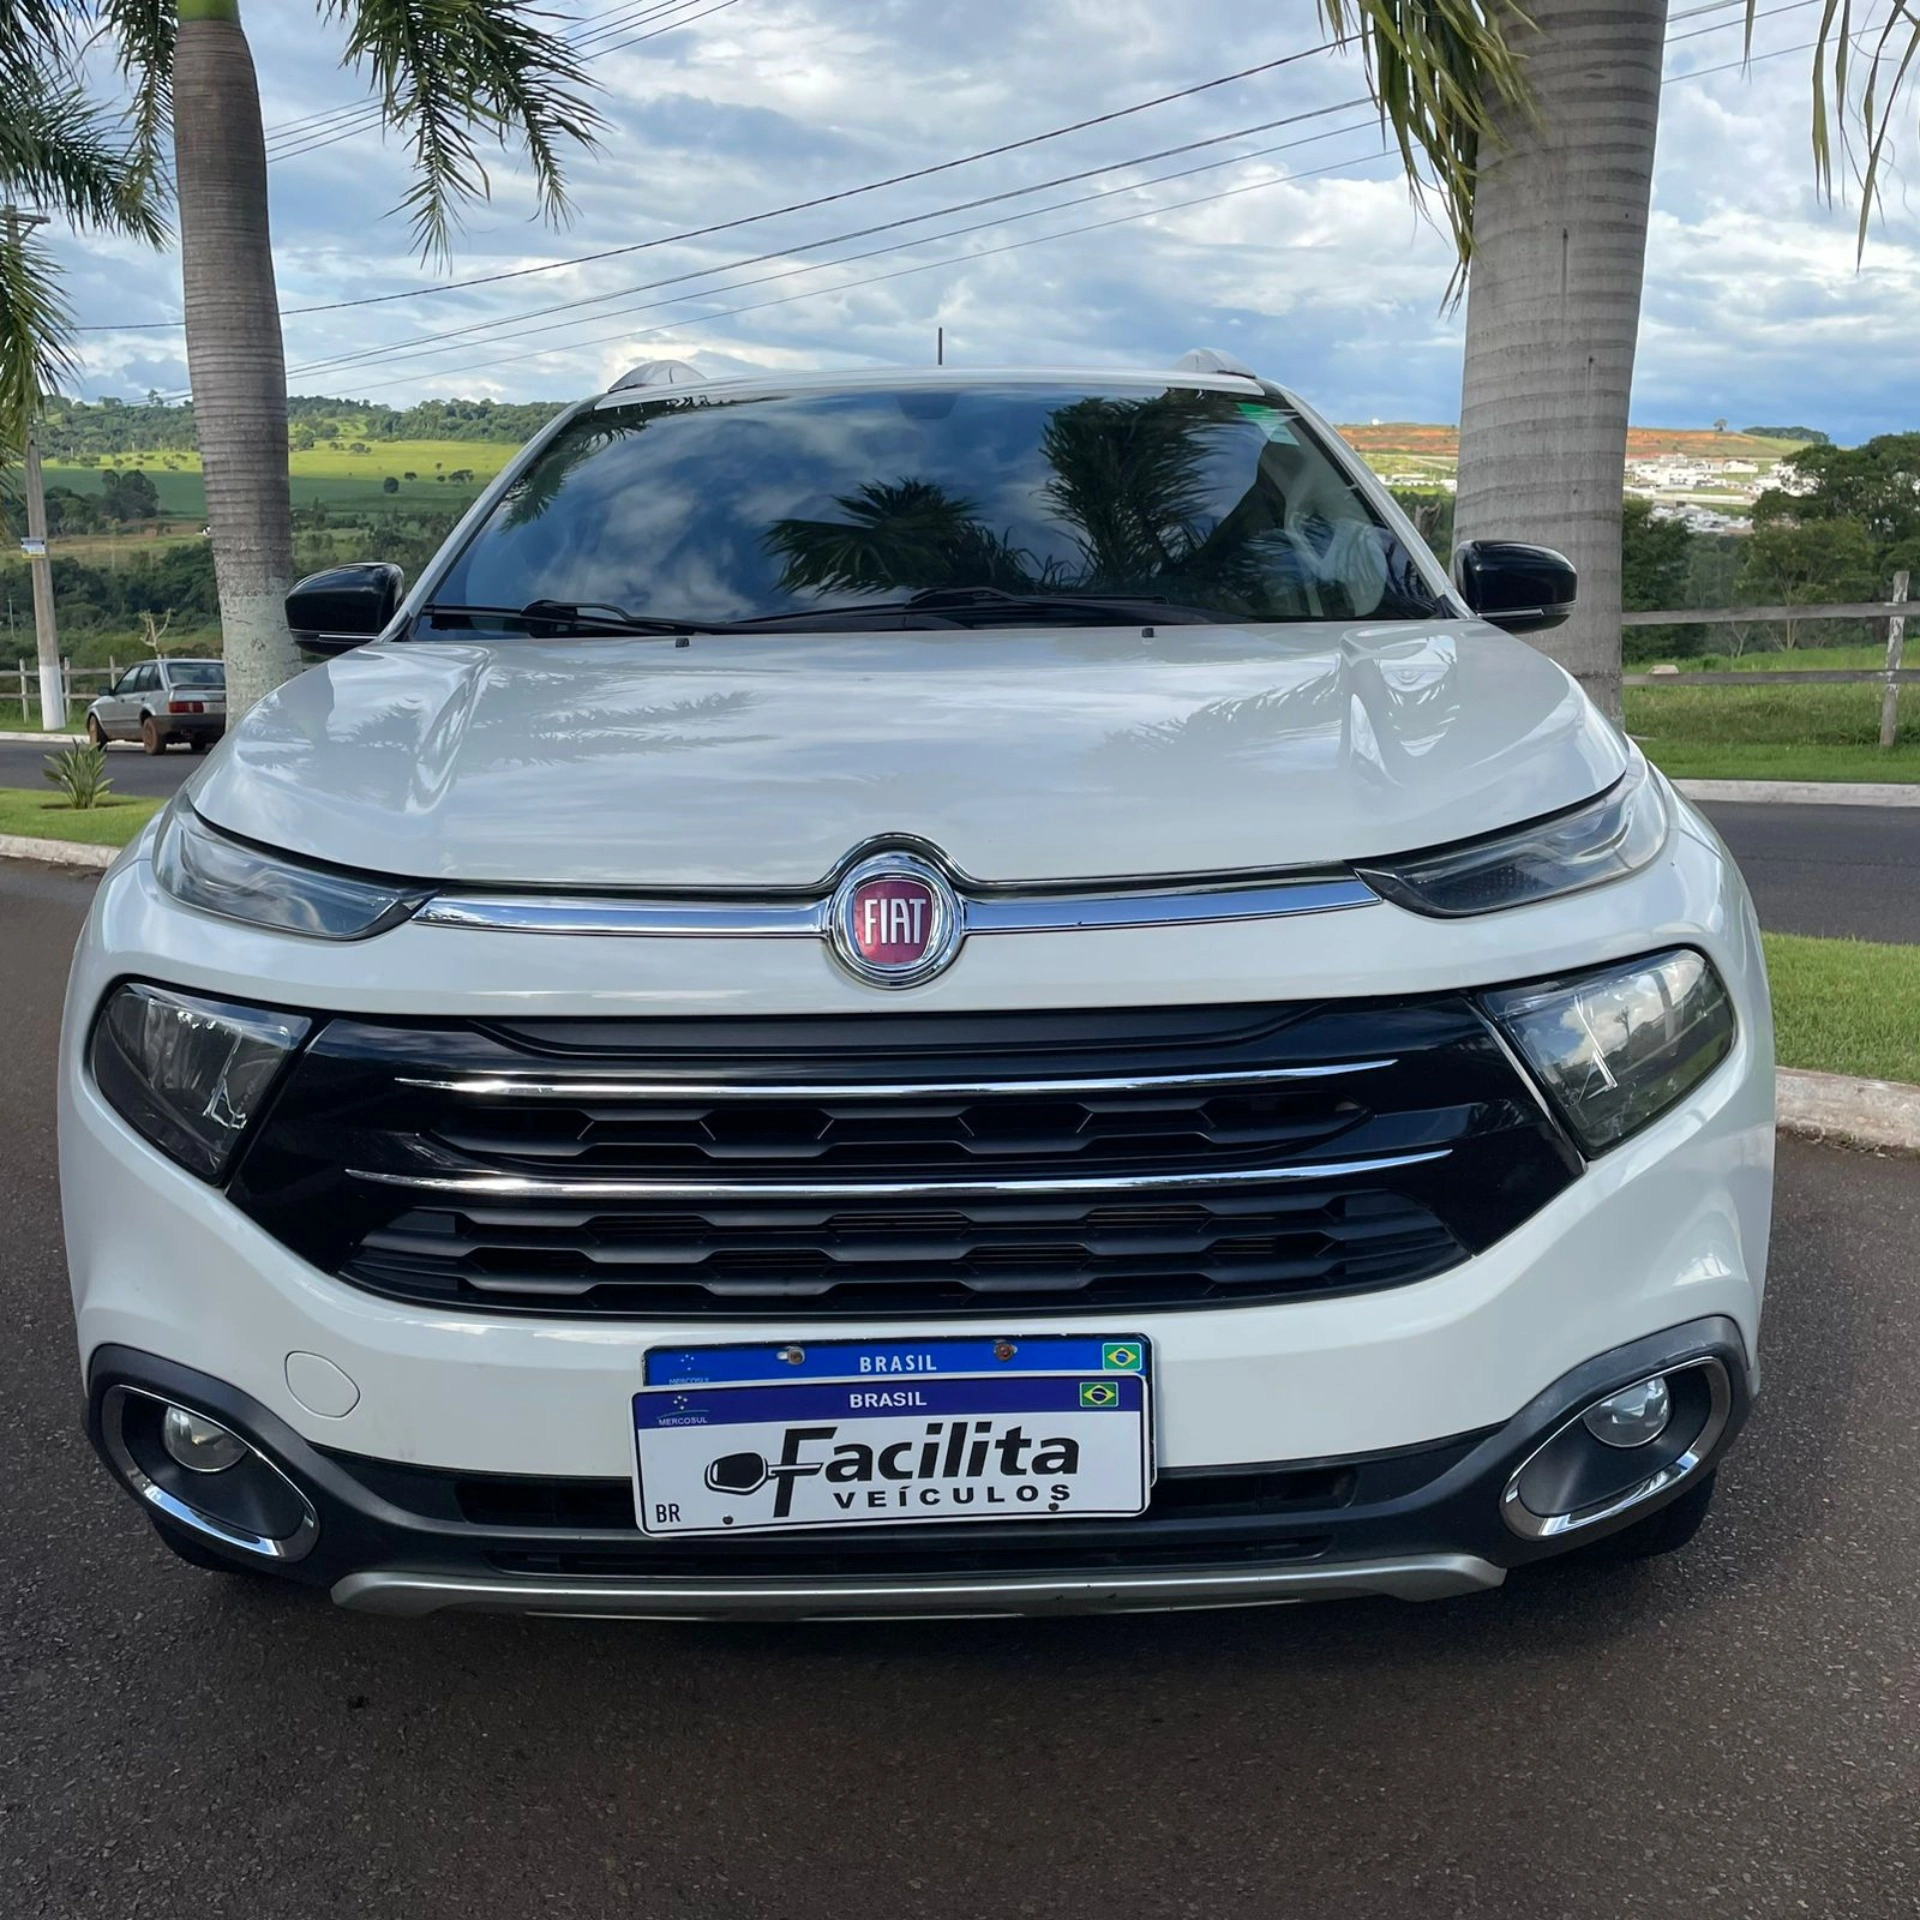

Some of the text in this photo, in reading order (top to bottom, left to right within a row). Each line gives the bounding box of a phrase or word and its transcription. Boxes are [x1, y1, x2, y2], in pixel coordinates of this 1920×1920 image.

[864, 898, 926, 944] FIAT
[859, 1354, 937, 1373] BRASIL
[849, 1391, 927, 1408] BRASIL
[658, 1416, 708, 1426] MERCOSUL
[773, 1421, 1080, 1518] Facilita
[832, 1483, 1071, 1510] VEÍCULOS
[655, 1503, 681, 1523] BR
